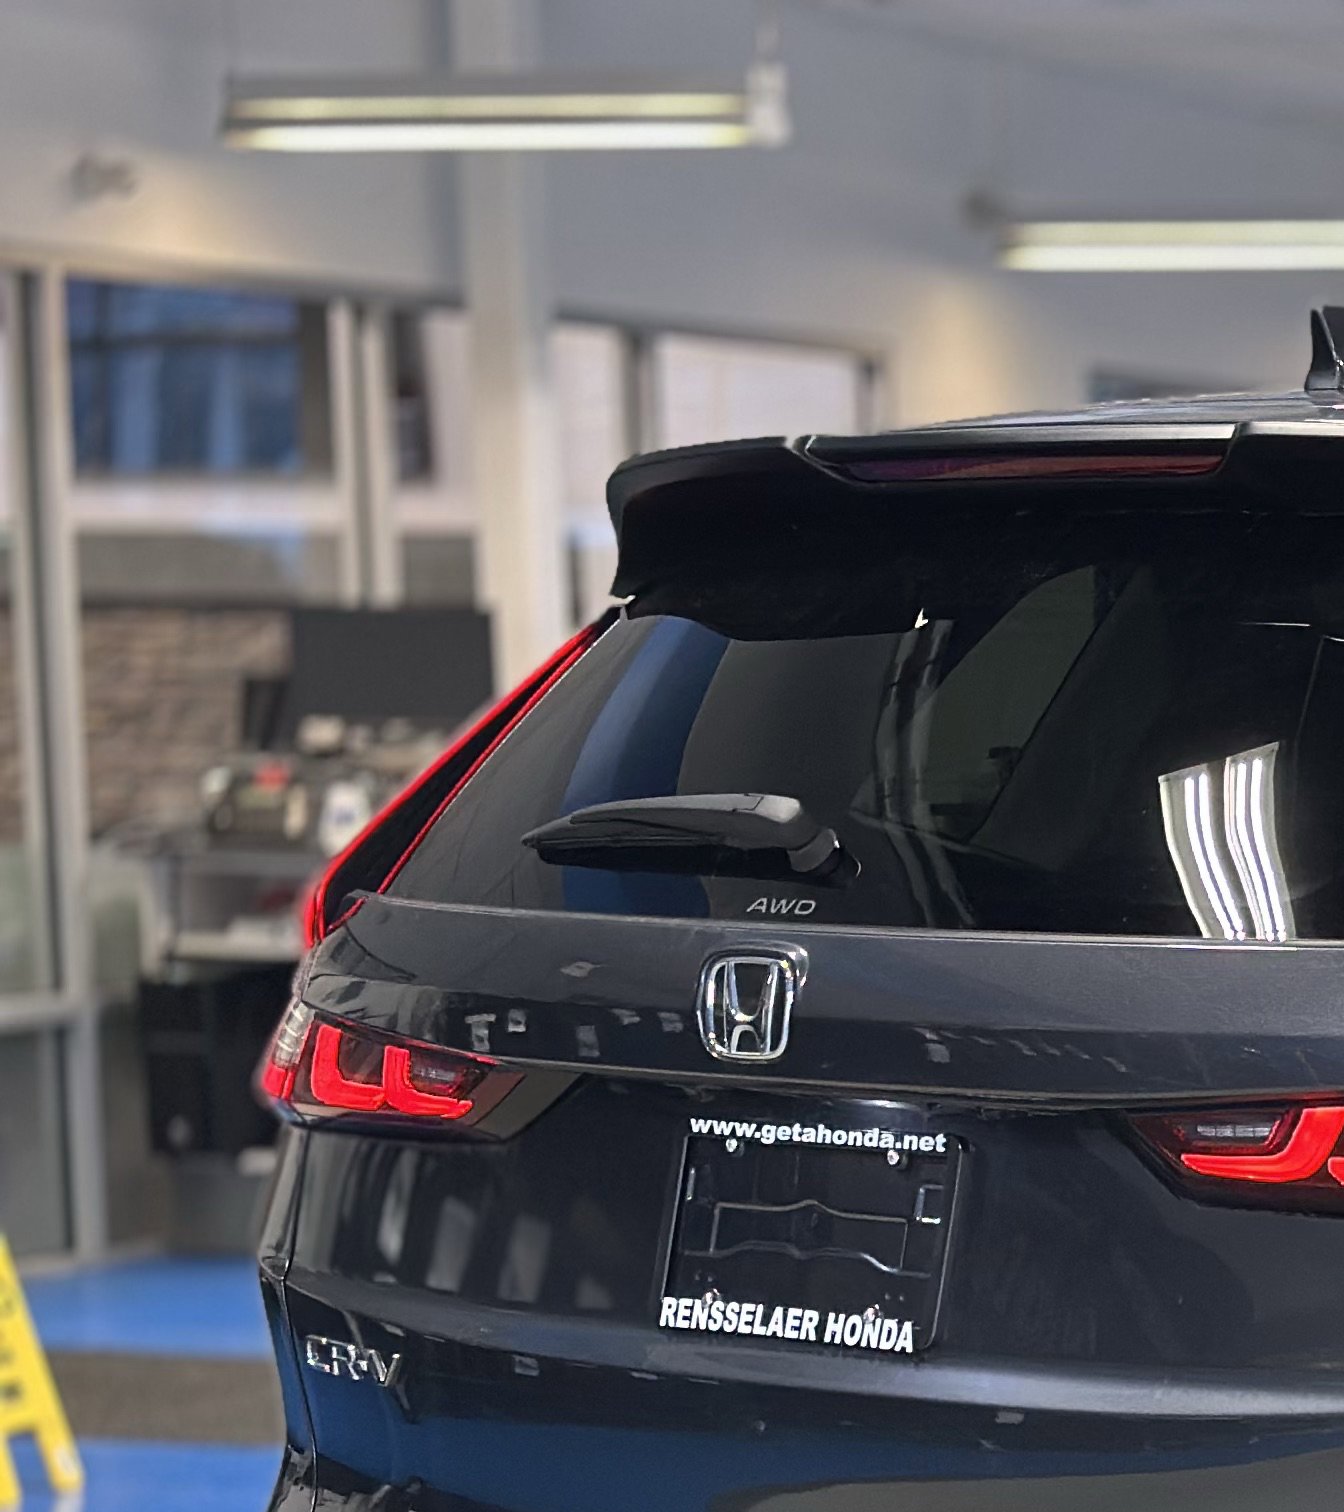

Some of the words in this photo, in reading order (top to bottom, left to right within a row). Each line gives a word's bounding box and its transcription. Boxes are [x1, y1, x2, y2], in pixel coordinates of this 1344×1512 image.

[747, 897, 816, 915] AWD
[690, 1117, 947, 1153] www.getahonda.net
[659, 1296, 819, 1341] RENSSELAER
[823, 1312, 914, 1354] HONDA
